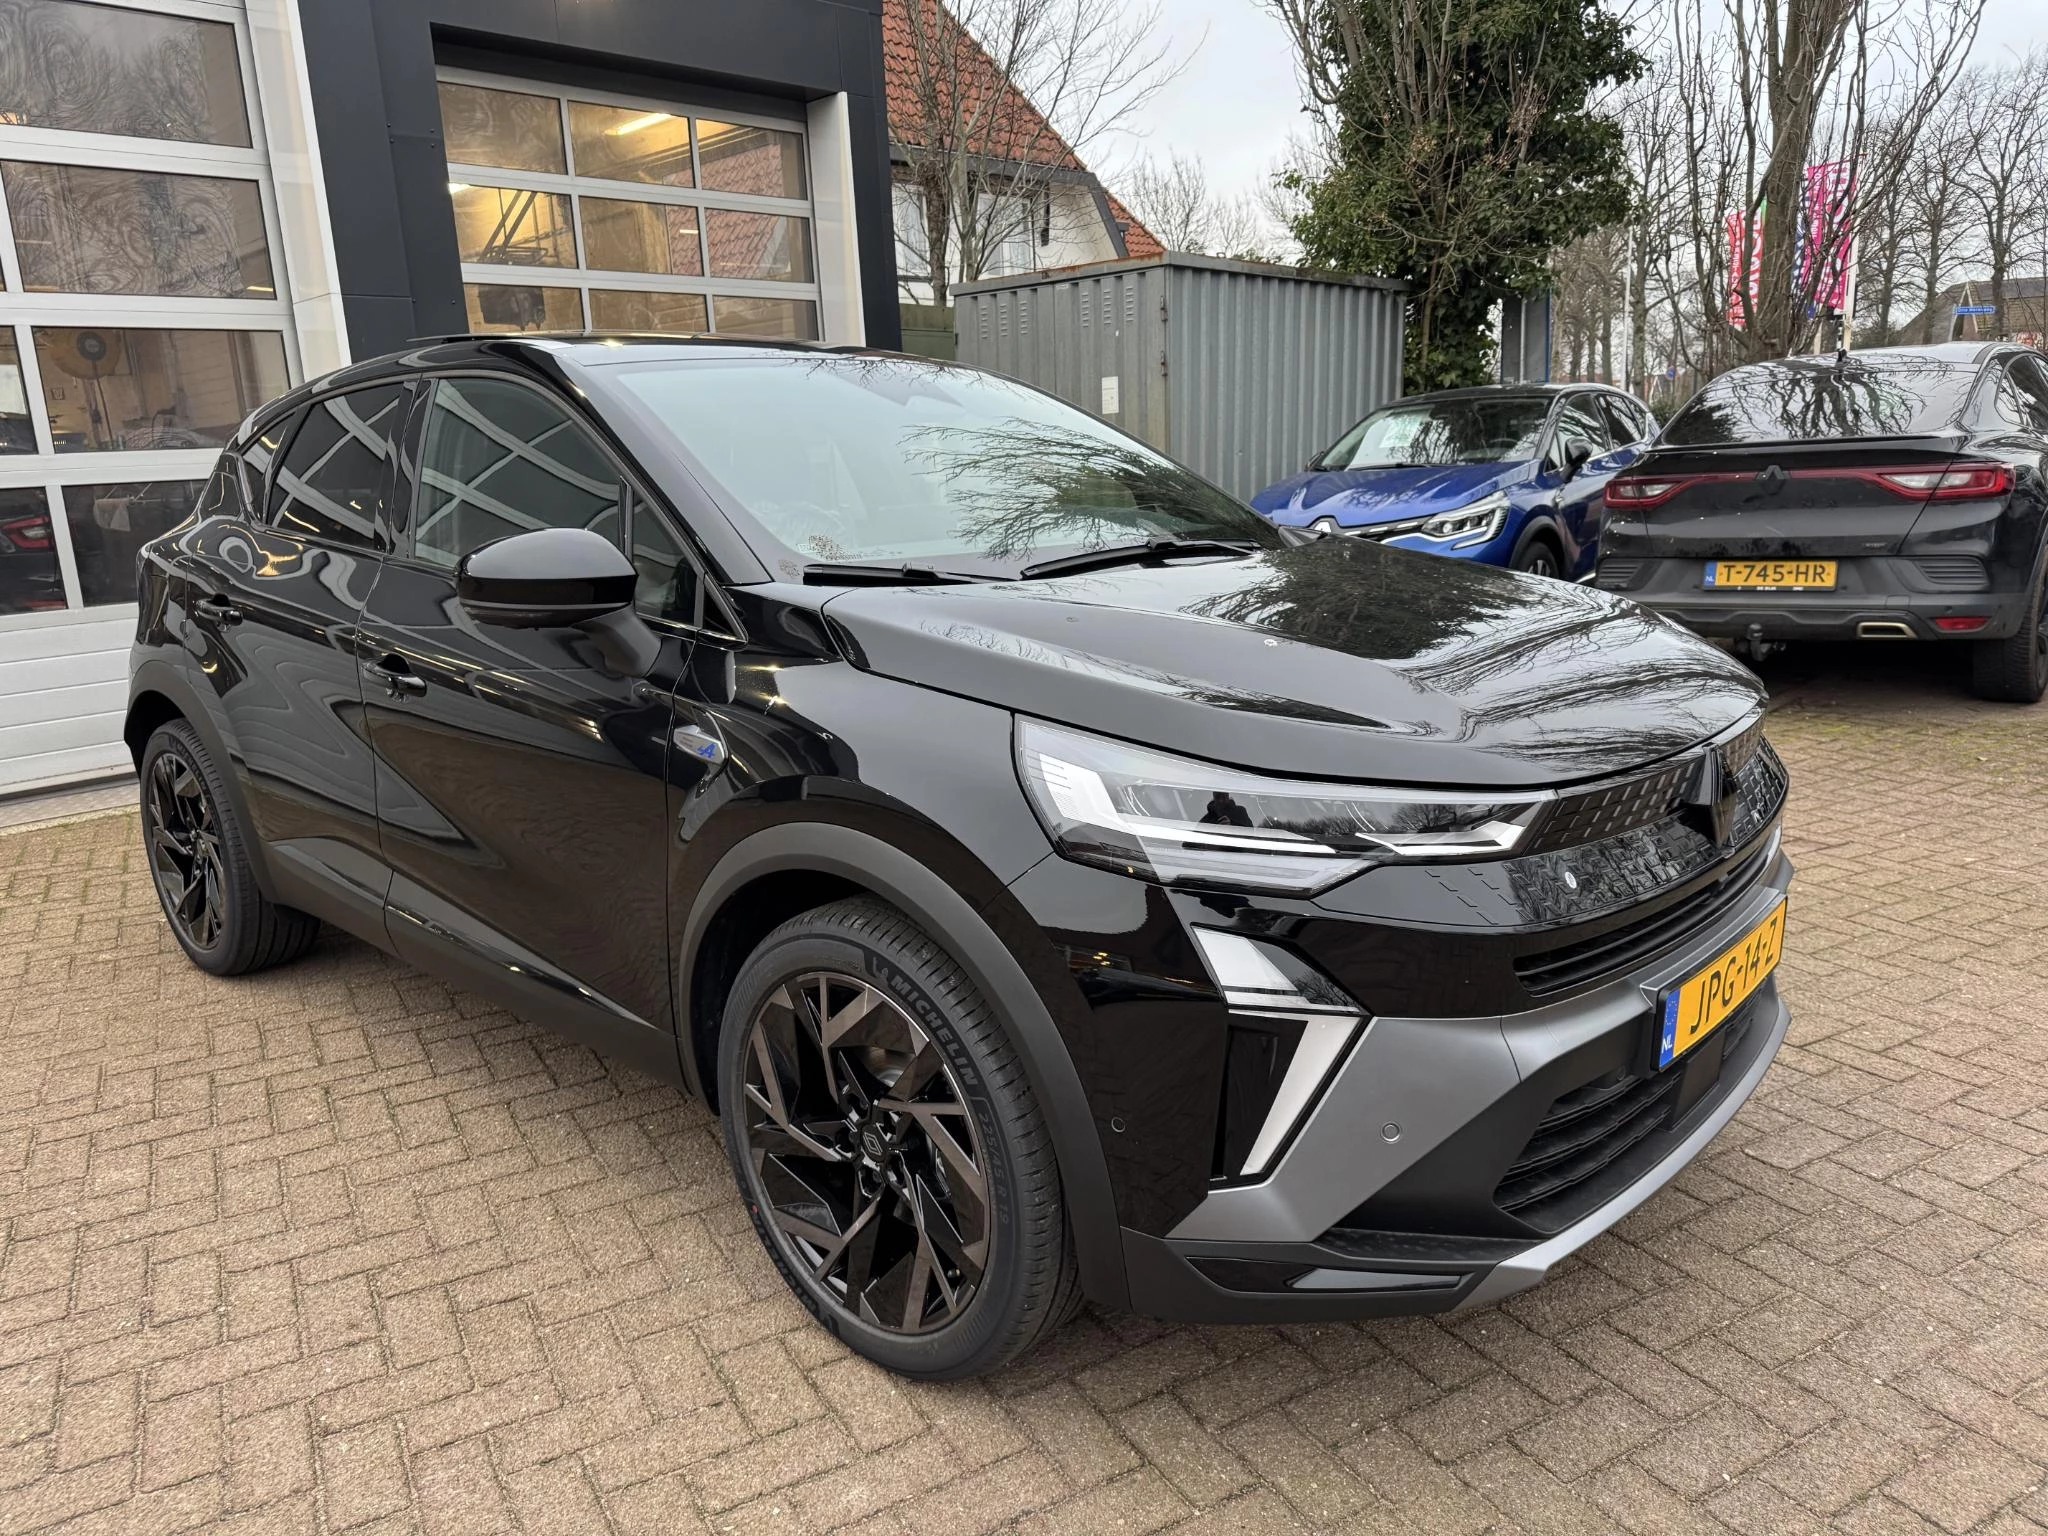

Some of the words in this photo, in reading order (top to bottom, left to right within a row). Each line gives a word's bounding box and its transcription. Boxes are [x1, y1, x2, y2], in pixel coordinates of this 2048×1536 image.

[1724, 564, 1826, 583] T-745-HR
[1690, 917, 1777, 1035] JPG-14-Z
[891, 974, 979, 1087] MICHELIN
[1661, 1033, 1673, 1054] NL
